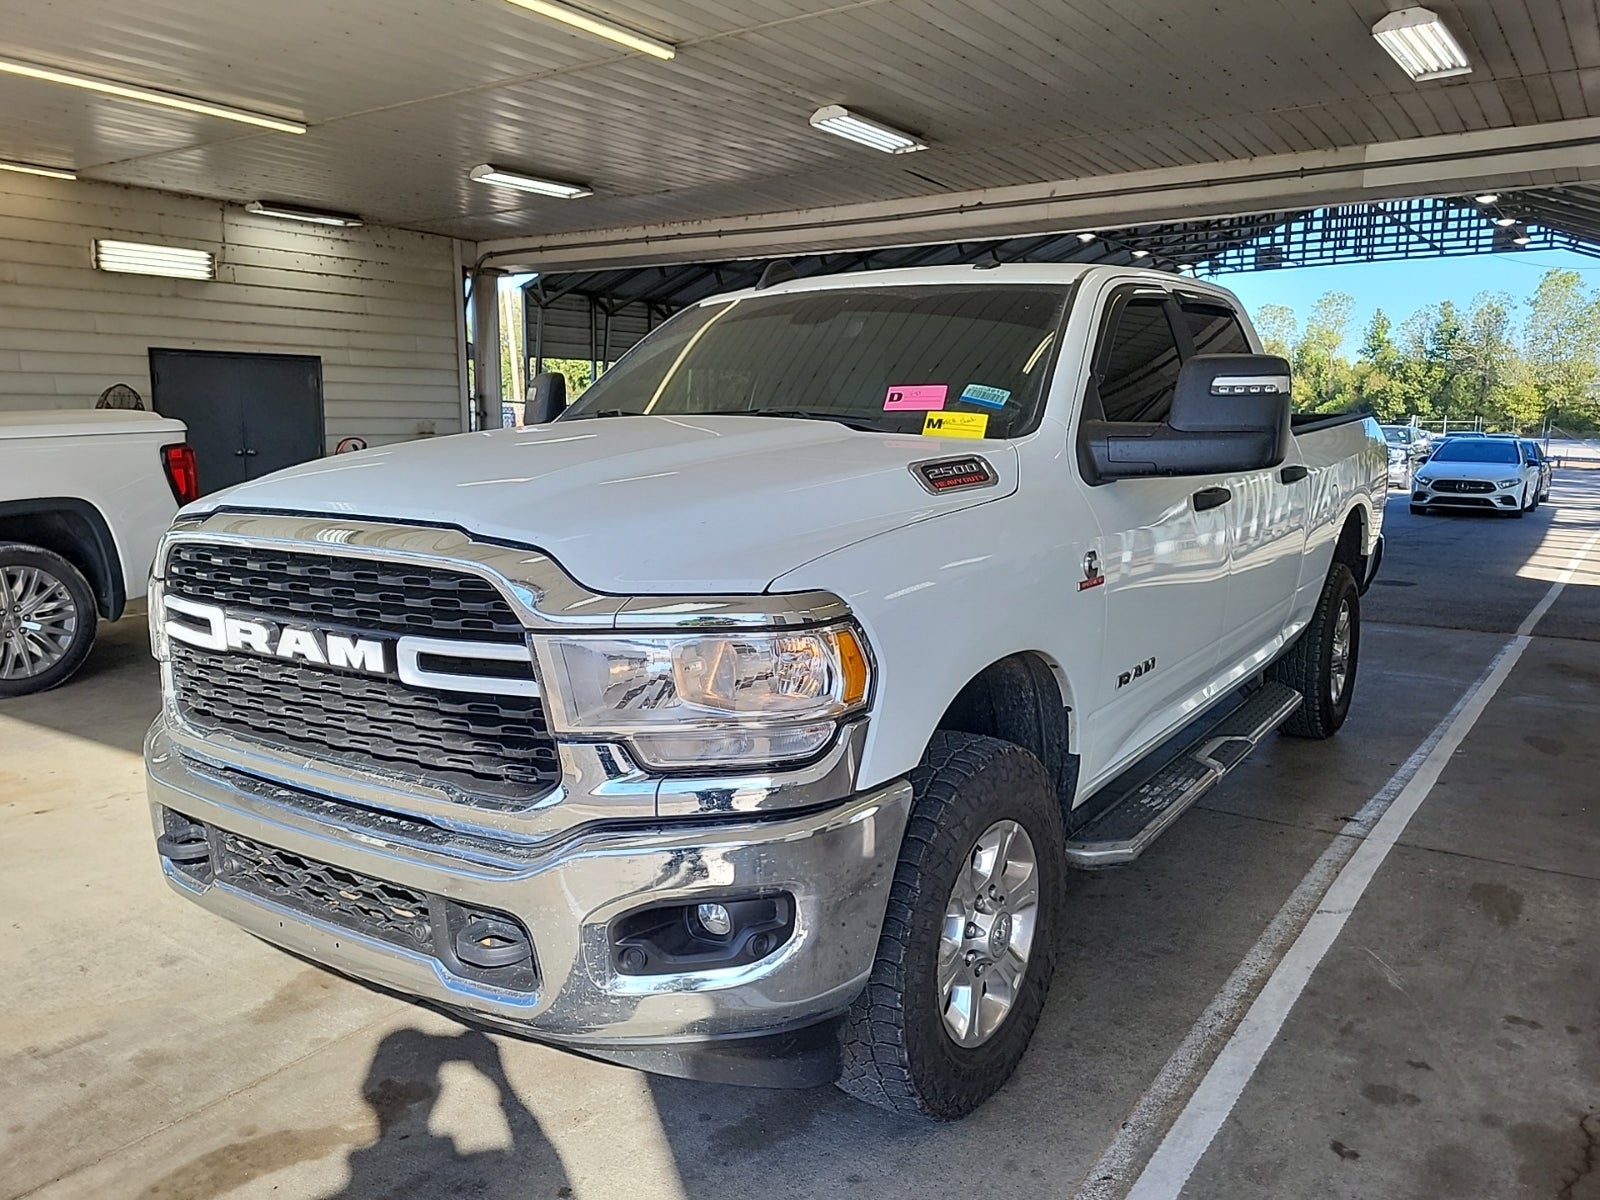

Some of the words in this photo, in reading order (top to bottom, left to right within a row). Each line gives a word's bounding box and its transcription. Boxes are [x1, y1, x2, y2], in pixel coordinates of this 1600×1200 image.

[889, 392, 903, 402] D
[926, 418, 943, 429] M
[927, 463, 979, 479] 2500
[934, 479, 962, 488] HEAVY
[963, 475, 984, 484] DUTY
[226, 618, 385, 673] RAM
[1115, 656, 1156, 689] RAM
